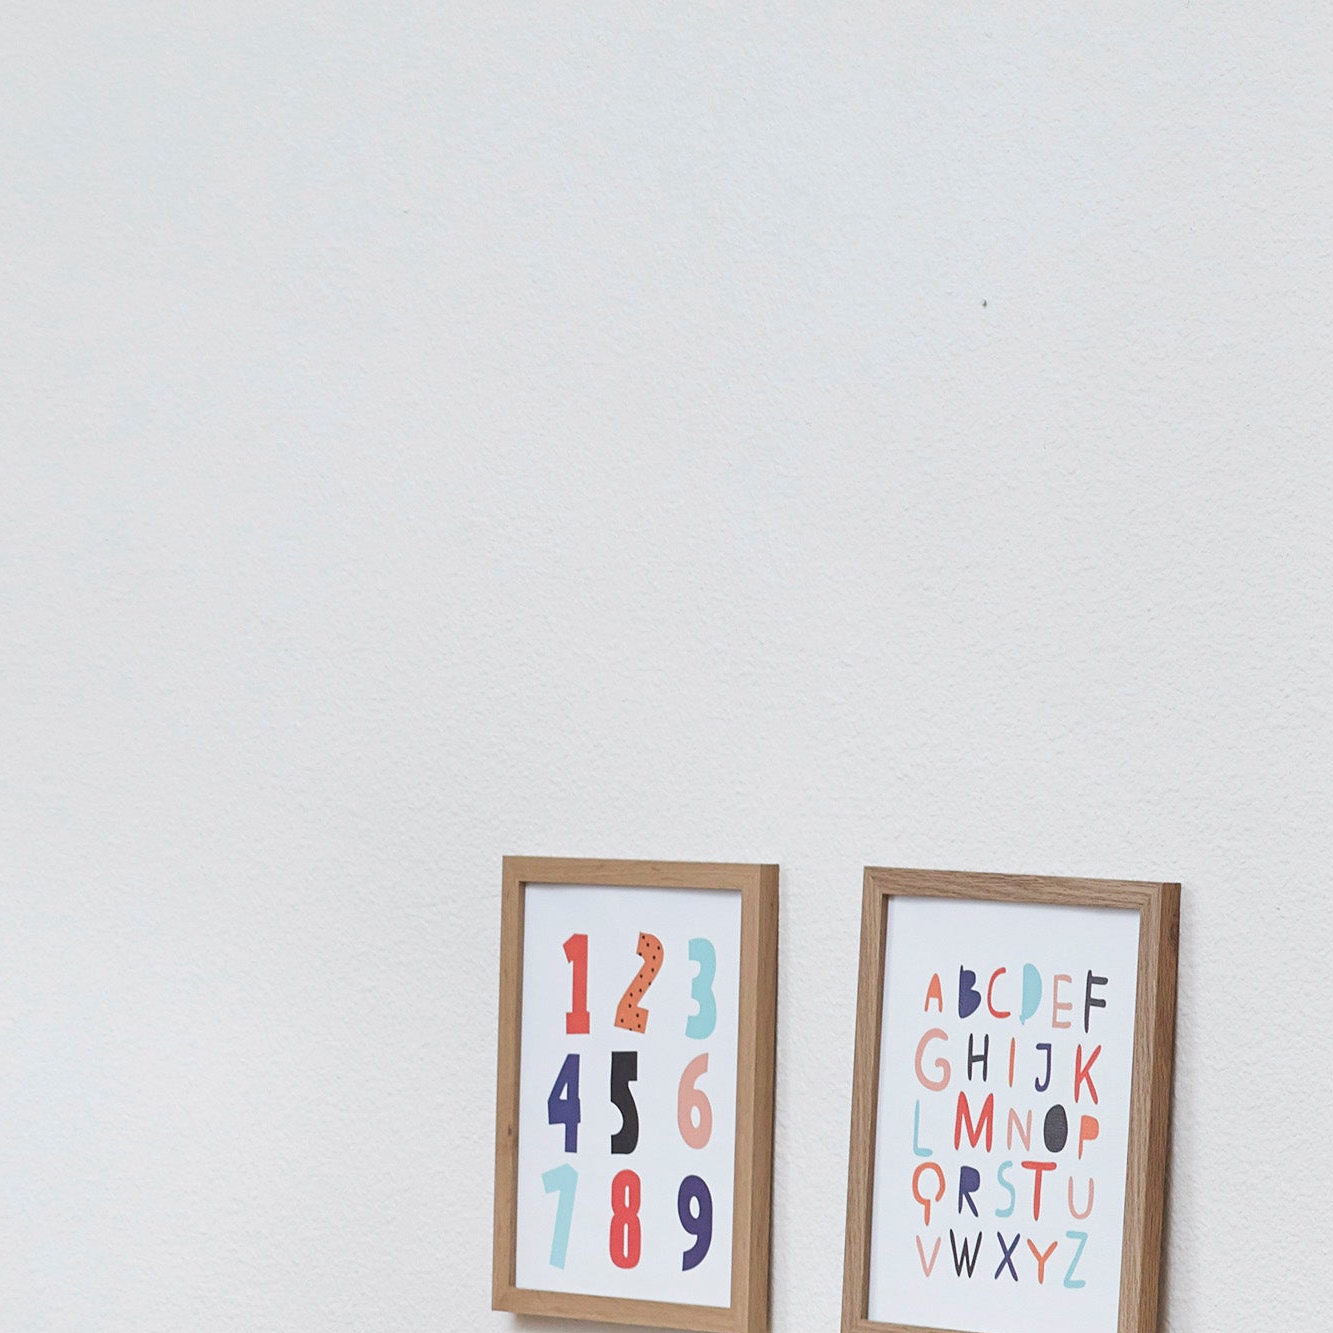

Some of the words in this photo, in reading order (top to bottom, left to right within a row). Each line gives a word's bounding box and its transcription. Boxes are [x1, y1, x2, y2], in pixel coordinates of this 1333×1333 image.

[563, 933, 590, 1034] 1
[613, 931, 664, 1034] 2
[685, 937, 717, 1040] 3
[547, 1053, 581, 1154] 4
[611, 1051, 639, 1154] 5
[676, 1052, 713, 1150] 6
[541, 1163, 579, 1270] 7
[609, 1169, 642, 1269] 8
[677, 1175, 713, 1272] 9
